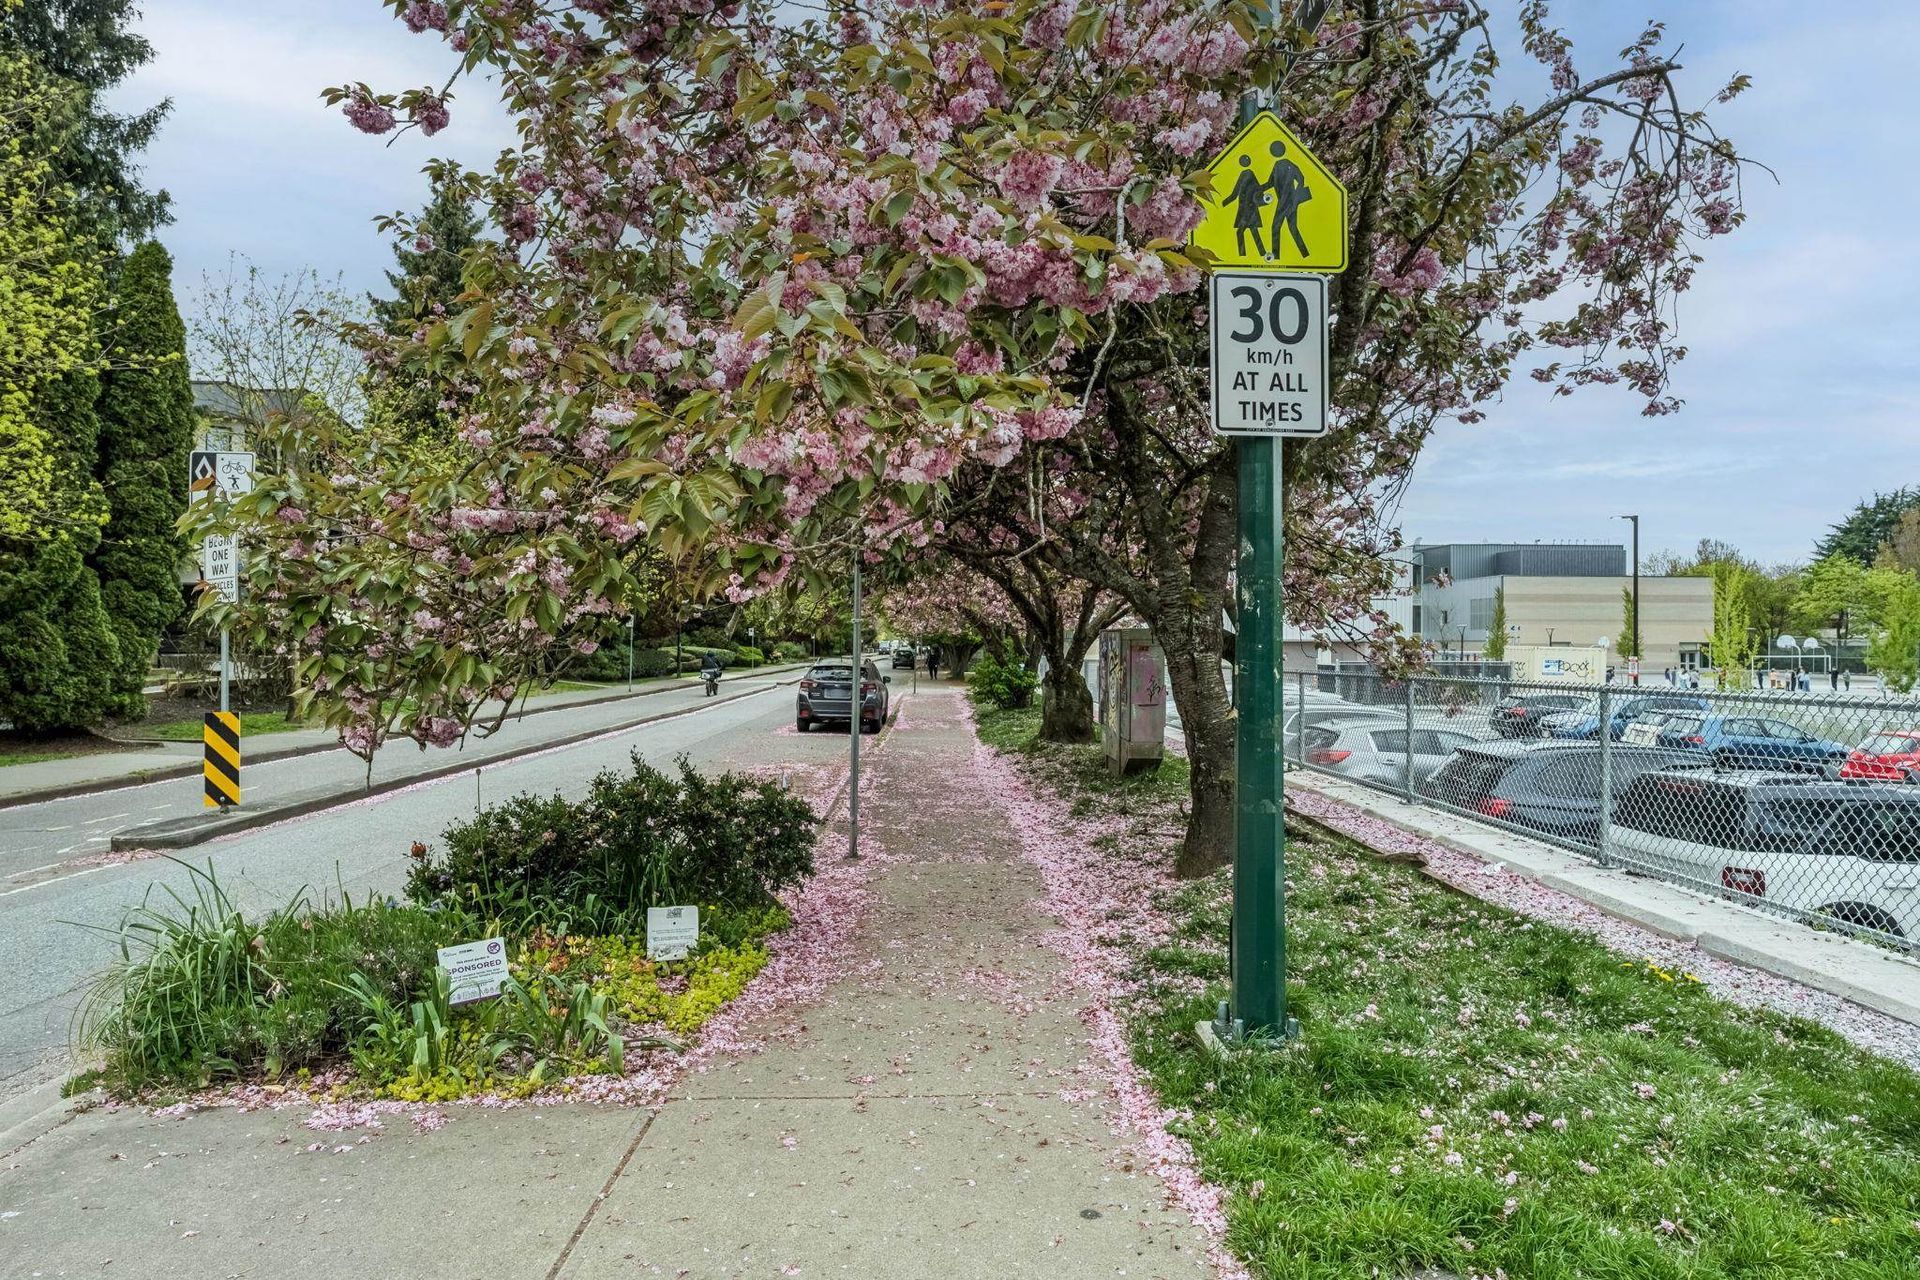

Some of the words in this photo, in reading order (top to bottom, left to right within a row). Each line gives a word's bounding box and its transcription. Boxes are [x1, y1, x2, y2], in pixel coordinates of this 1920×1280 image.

[1230, 286, 1309, 345] 30
[1247, 347, 1293, 366] km/h
[1232, 371, 1259, 391] AT
[1269, 372, 1309, 393] ALL
[1238, 401, 1303, 422] TIMES
[208, 537, 233, 549] BEGIN
[212, 549, 229, 561] ONE
[212, 563, 229, 576] WAY
[447, 959, 502, 976] SPONSORED
